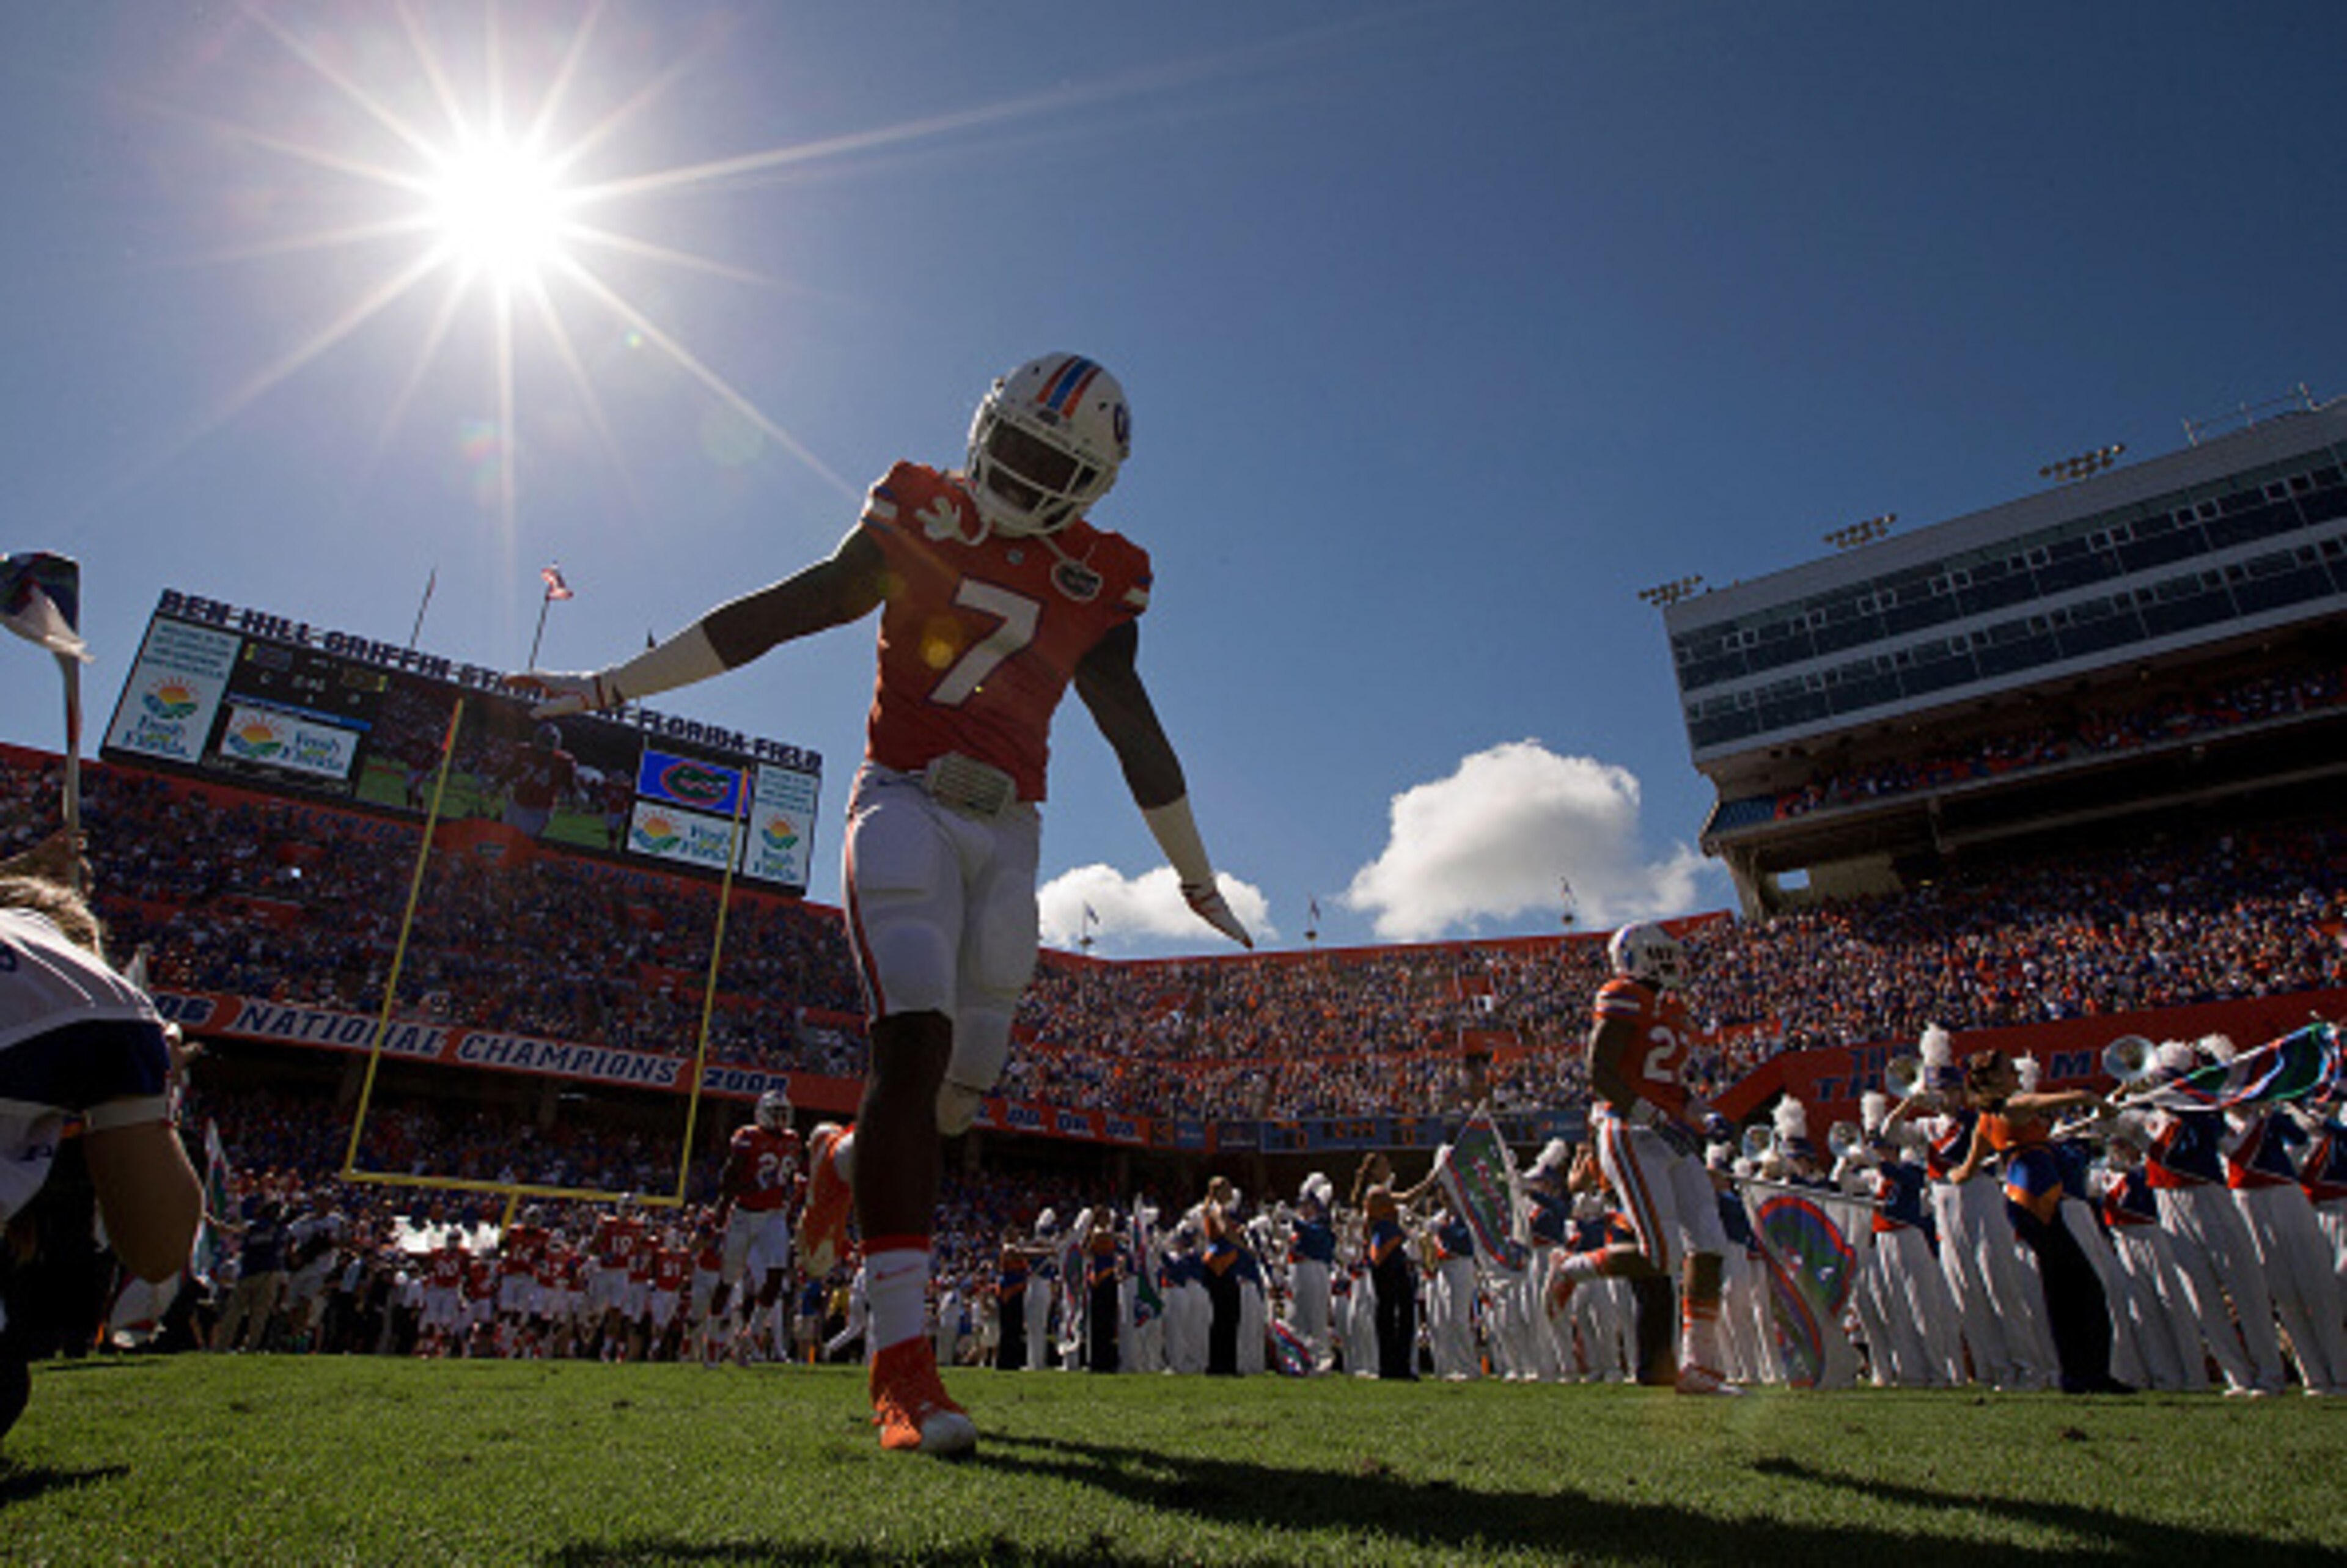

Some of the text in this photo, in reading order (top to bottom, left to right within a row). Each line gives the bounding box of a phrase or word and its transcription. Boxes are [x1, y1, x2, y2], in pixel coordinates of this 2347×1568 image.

[925, 575, 1046, 707] 7
[639, 708, 745, 753] FLORIDA
[754, 737, 823, 772] FIELD
[236, 1004, 443, 1053] NATIONAL
[460, 1035, 678, 1083] CHAMPIONS
